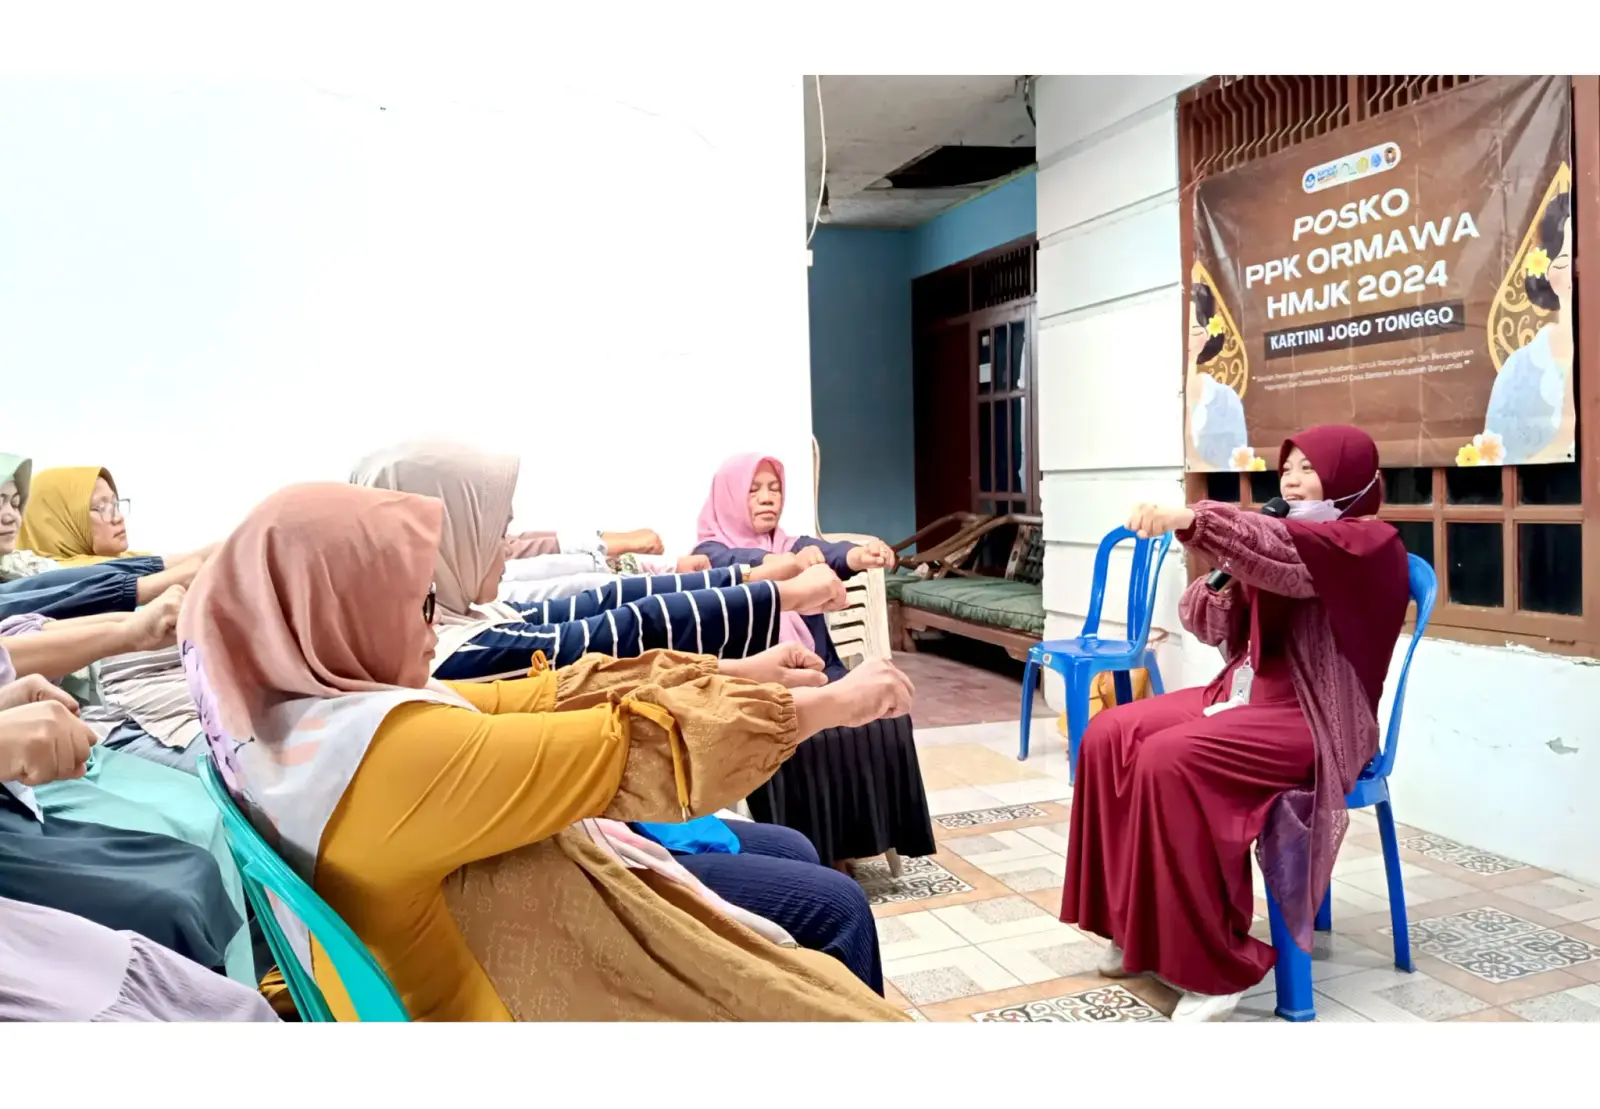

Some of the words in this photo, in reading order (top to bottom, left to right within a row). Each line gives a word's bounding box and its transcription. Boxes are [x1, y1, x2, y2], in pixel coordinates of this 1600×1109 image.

[1292, 187, 1410, 242] POSKO
[1245, 253, 1302, 289] PPK
[1306, 211, 1480, 275] ORMAWA
[1266, 279, 1351, 319] HMJK
[1357, 259, 1448, 302] 2024
[1270, 327, 1325, 350] KARTINI
[1327, 320, 1372, 342] JOGO
[1374, 306, 1454, 334] TONGGO
